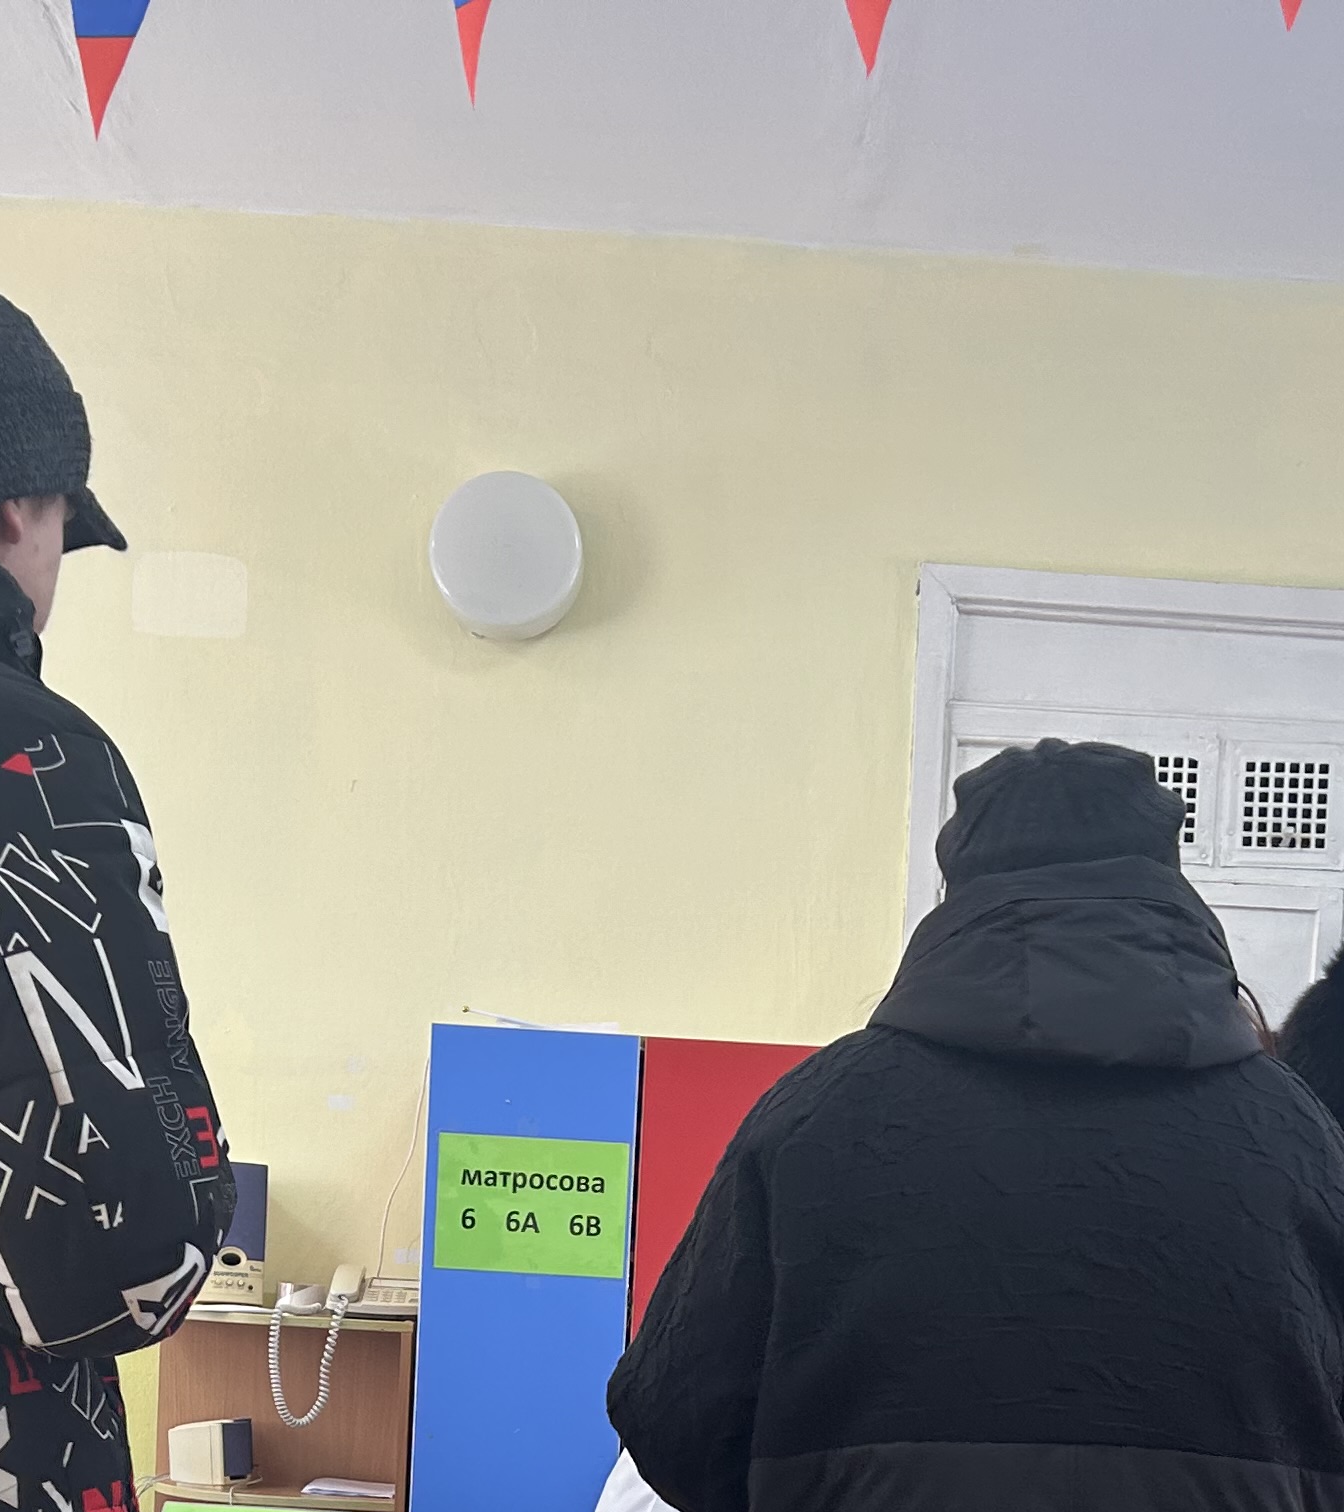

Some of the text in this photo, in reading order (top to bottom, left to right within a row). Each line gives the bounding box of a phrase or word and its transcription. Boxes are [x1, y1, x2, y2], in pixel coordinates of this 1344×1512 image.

[461, 1168, 605, 1193] матросова
[461, 1208, 602, 1237] 6 6А 6В
